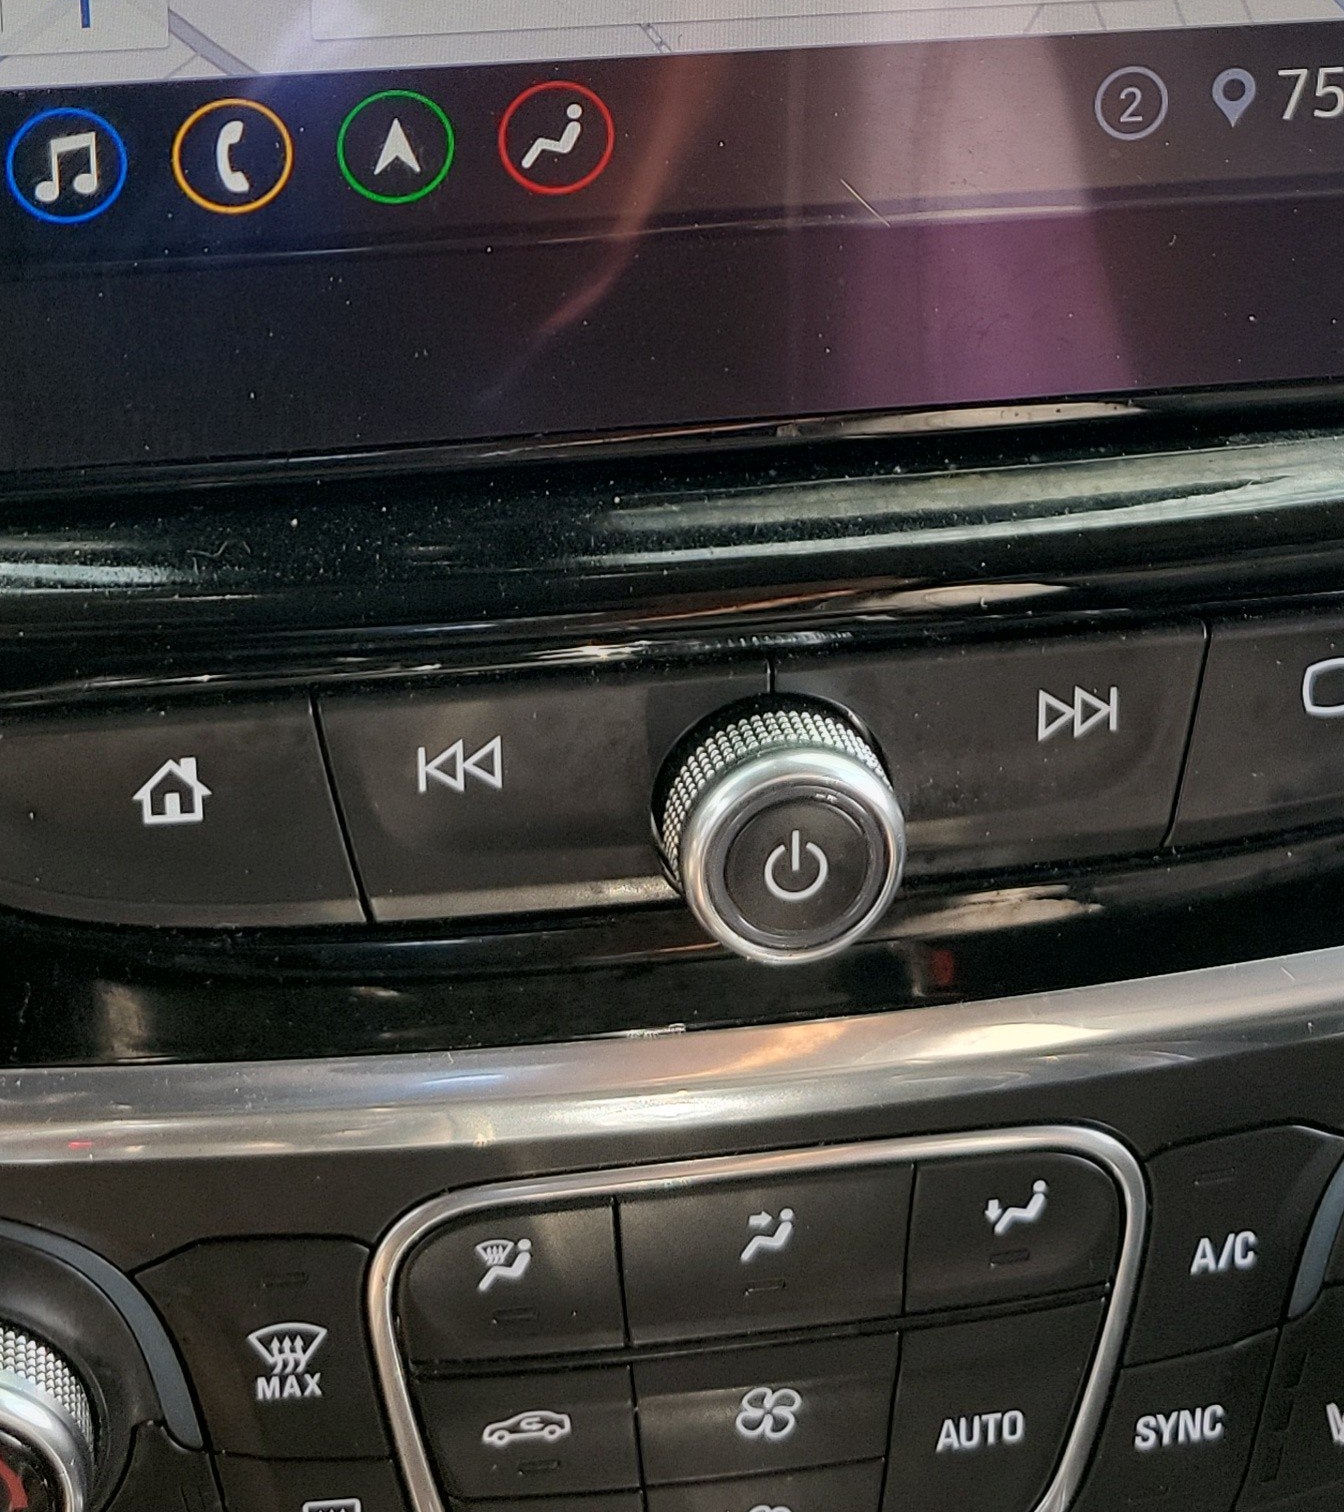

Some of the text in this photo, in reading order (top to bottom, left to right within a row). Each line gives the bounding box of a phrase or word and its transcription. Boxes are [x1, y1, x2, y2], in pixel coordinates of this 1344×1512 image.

[1190, 1230, 1256, 1276] A/C
[255, 1372, 323, 1400] MAX
[935, 1409, 1024, 1453] AUTO
[1133, 1404, 1224, 1450] SYNC
